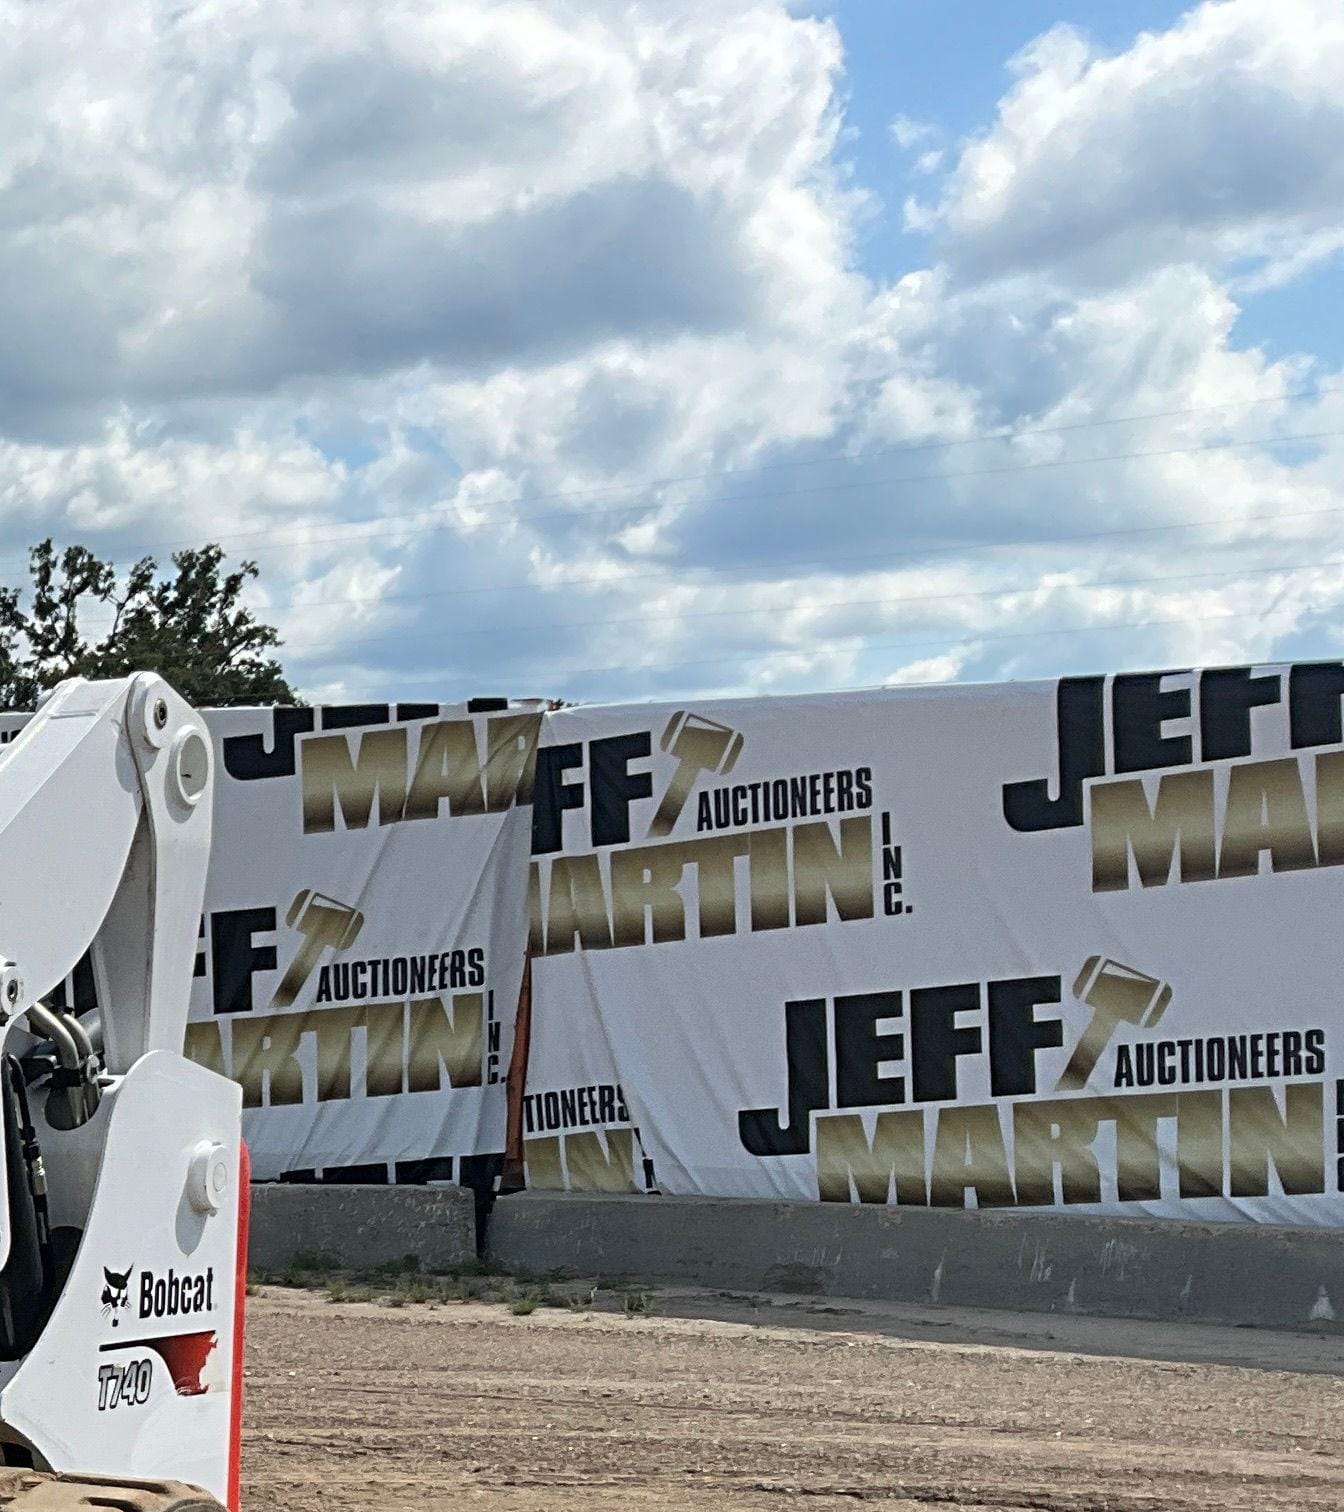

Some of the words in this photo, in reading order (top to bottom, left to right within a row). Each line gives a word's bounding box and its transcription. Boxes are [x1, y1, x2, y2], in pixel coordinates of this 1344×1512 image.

[697, 767, 872, 832] AUCTIONEERS
[529, 815, 874, 958] ARTIN
[316, 947, 485, 1003] AUCTIONEERS
[738, 975, 1064, 1156] JEFF
[1114, 1029, 1326, 1089] AUCTIONEERS
[816, 1082, 1325, 1209] MARTIN
[139, 1266, 213, 1319] Bobcat
[98, 1358, 153, 1411] T740
